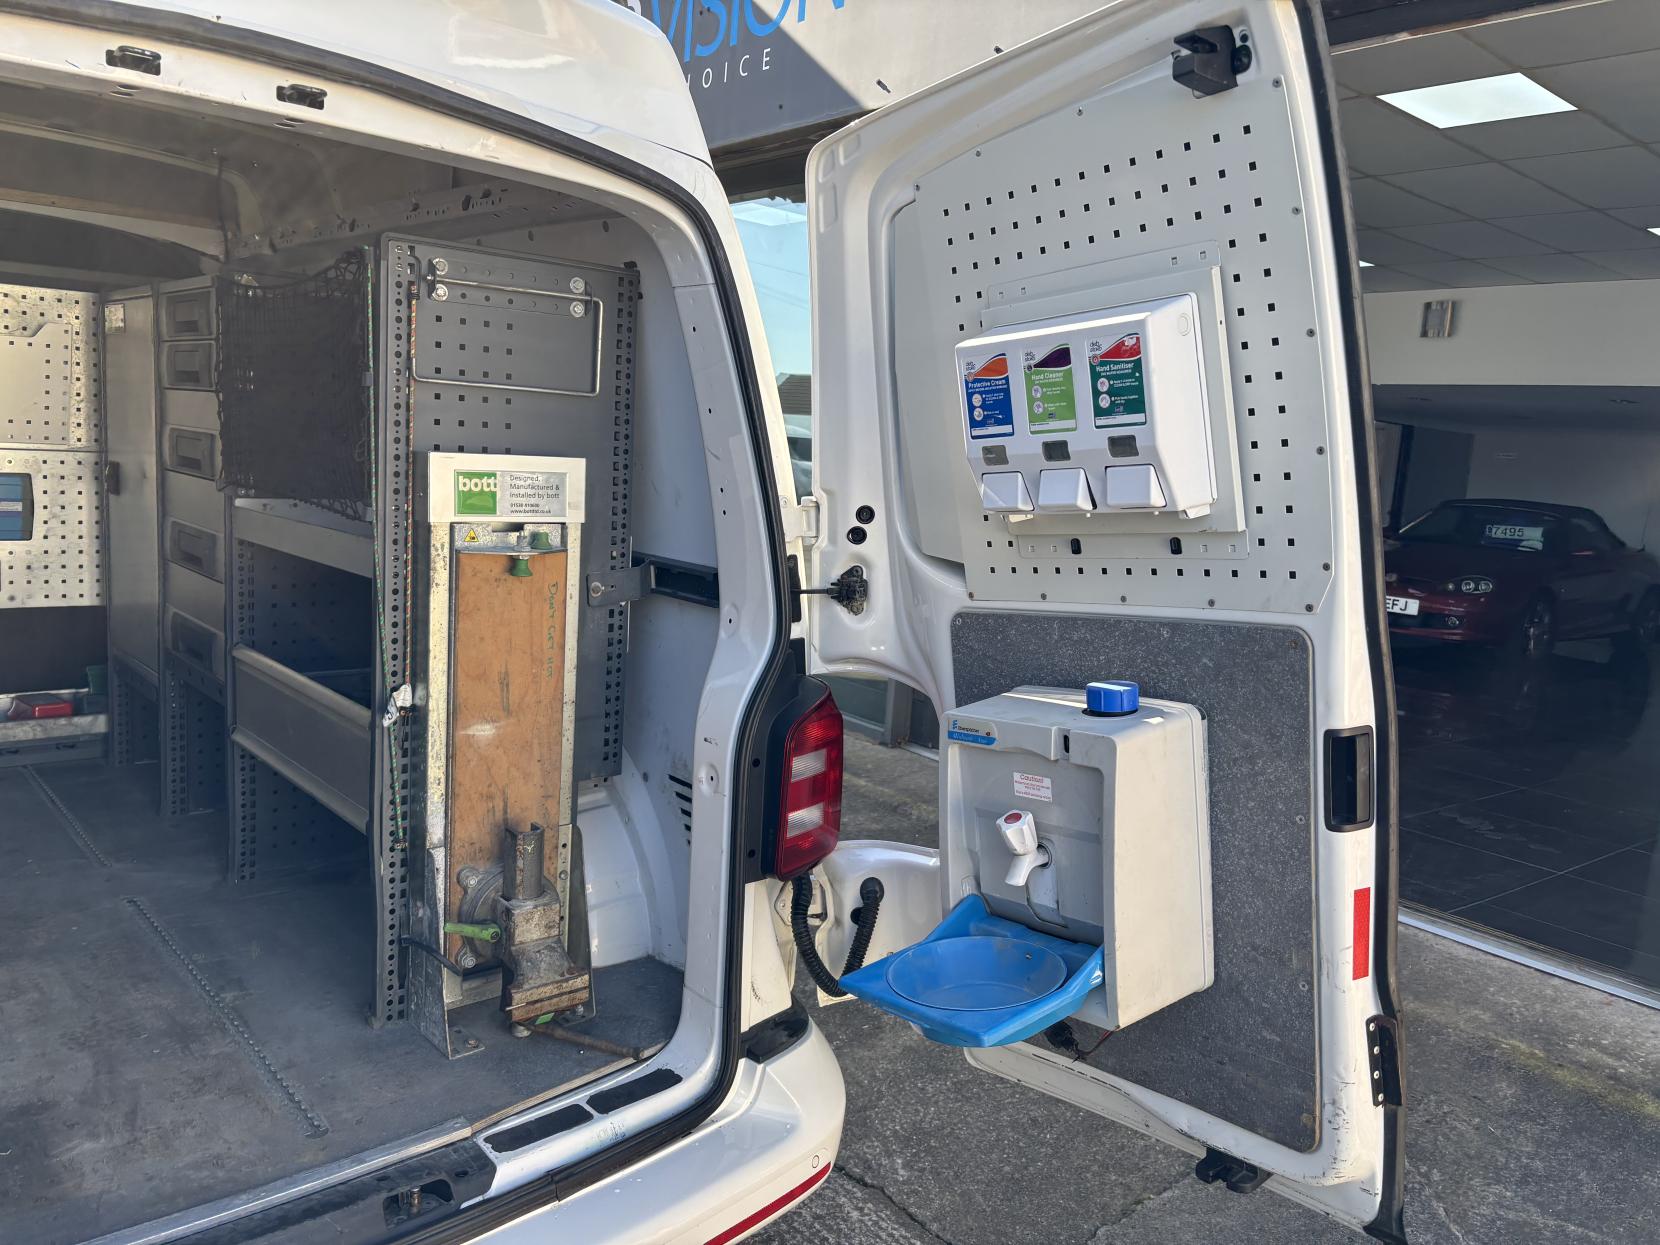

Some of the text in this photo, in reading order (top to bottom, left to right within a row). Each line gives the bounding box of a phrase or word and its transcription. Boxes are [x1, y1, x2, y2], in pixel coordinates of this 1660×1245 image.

[1096, 362, 1135, 373] Hand Sanitiser
[1031, 373, 1044, 381] Hand
[990, 379, 1006, 387] Cream
[509, 474, 541, 483] Designed,
[458, 475, 497, 492] bott
[509, 483, 554, 491] Manufactured
[538, 492, 546, 500] by
